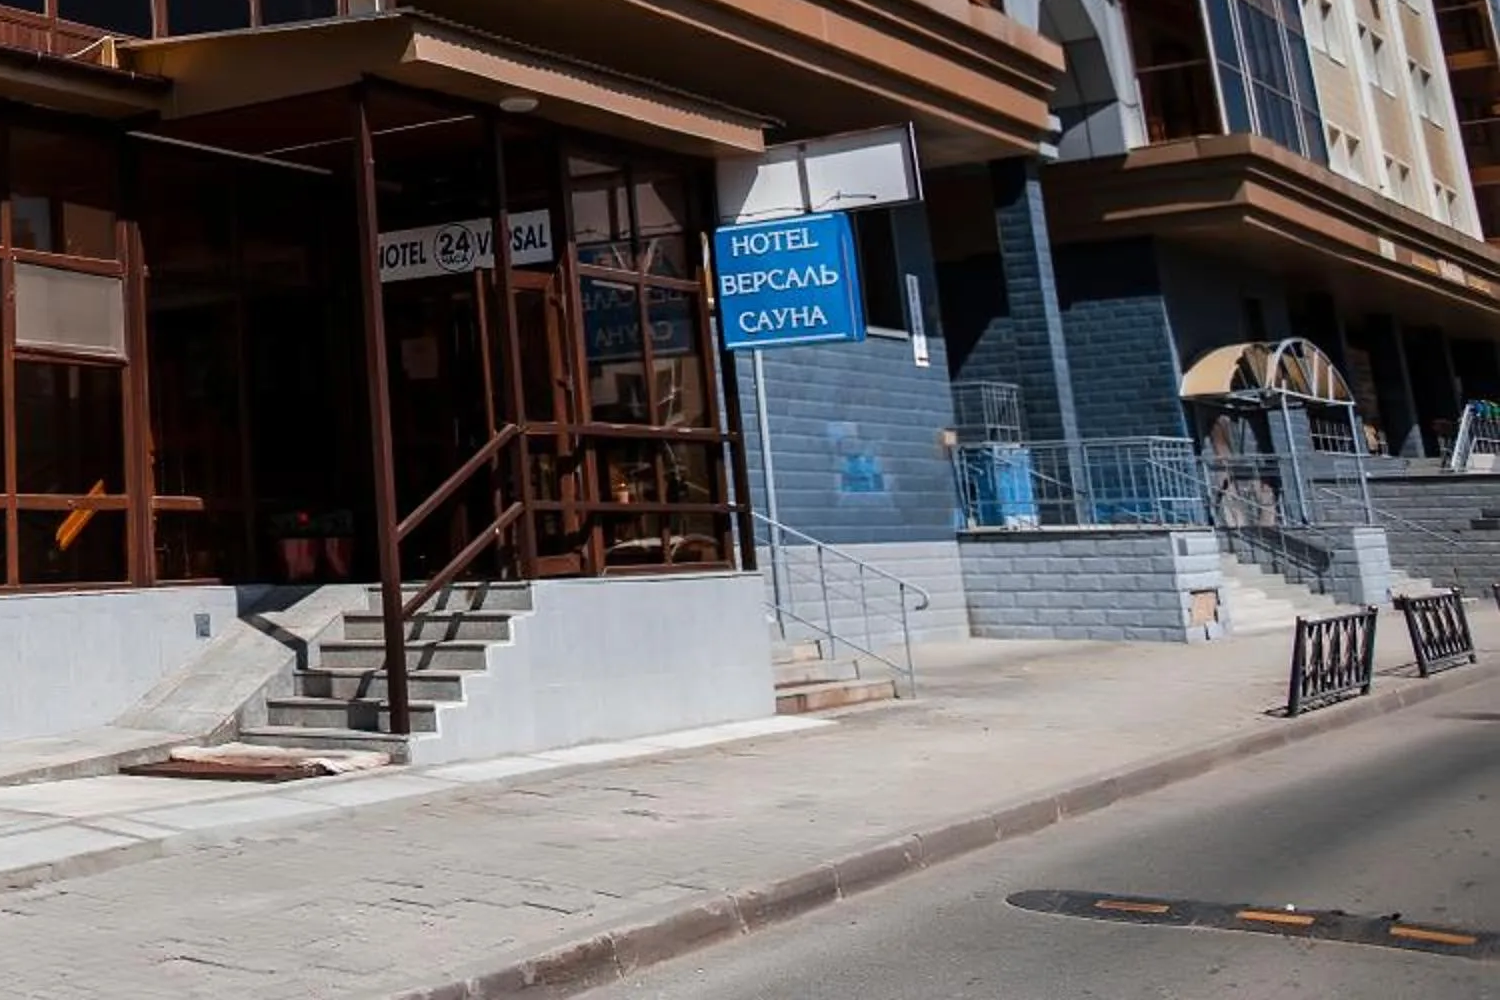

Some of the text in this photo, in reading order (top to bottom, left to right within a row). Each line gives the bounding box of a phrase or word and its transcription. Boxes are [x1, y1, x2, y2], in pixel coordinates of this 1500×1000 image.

[441, 231, 470, 256] 24
[476, 223, 547, 256] VSAL
[731, 228, 819, 257] HOTEL
[720, 264, 839, 297] ВЕРСАЛЬ
[738, 304, 829, 333] САУНА
